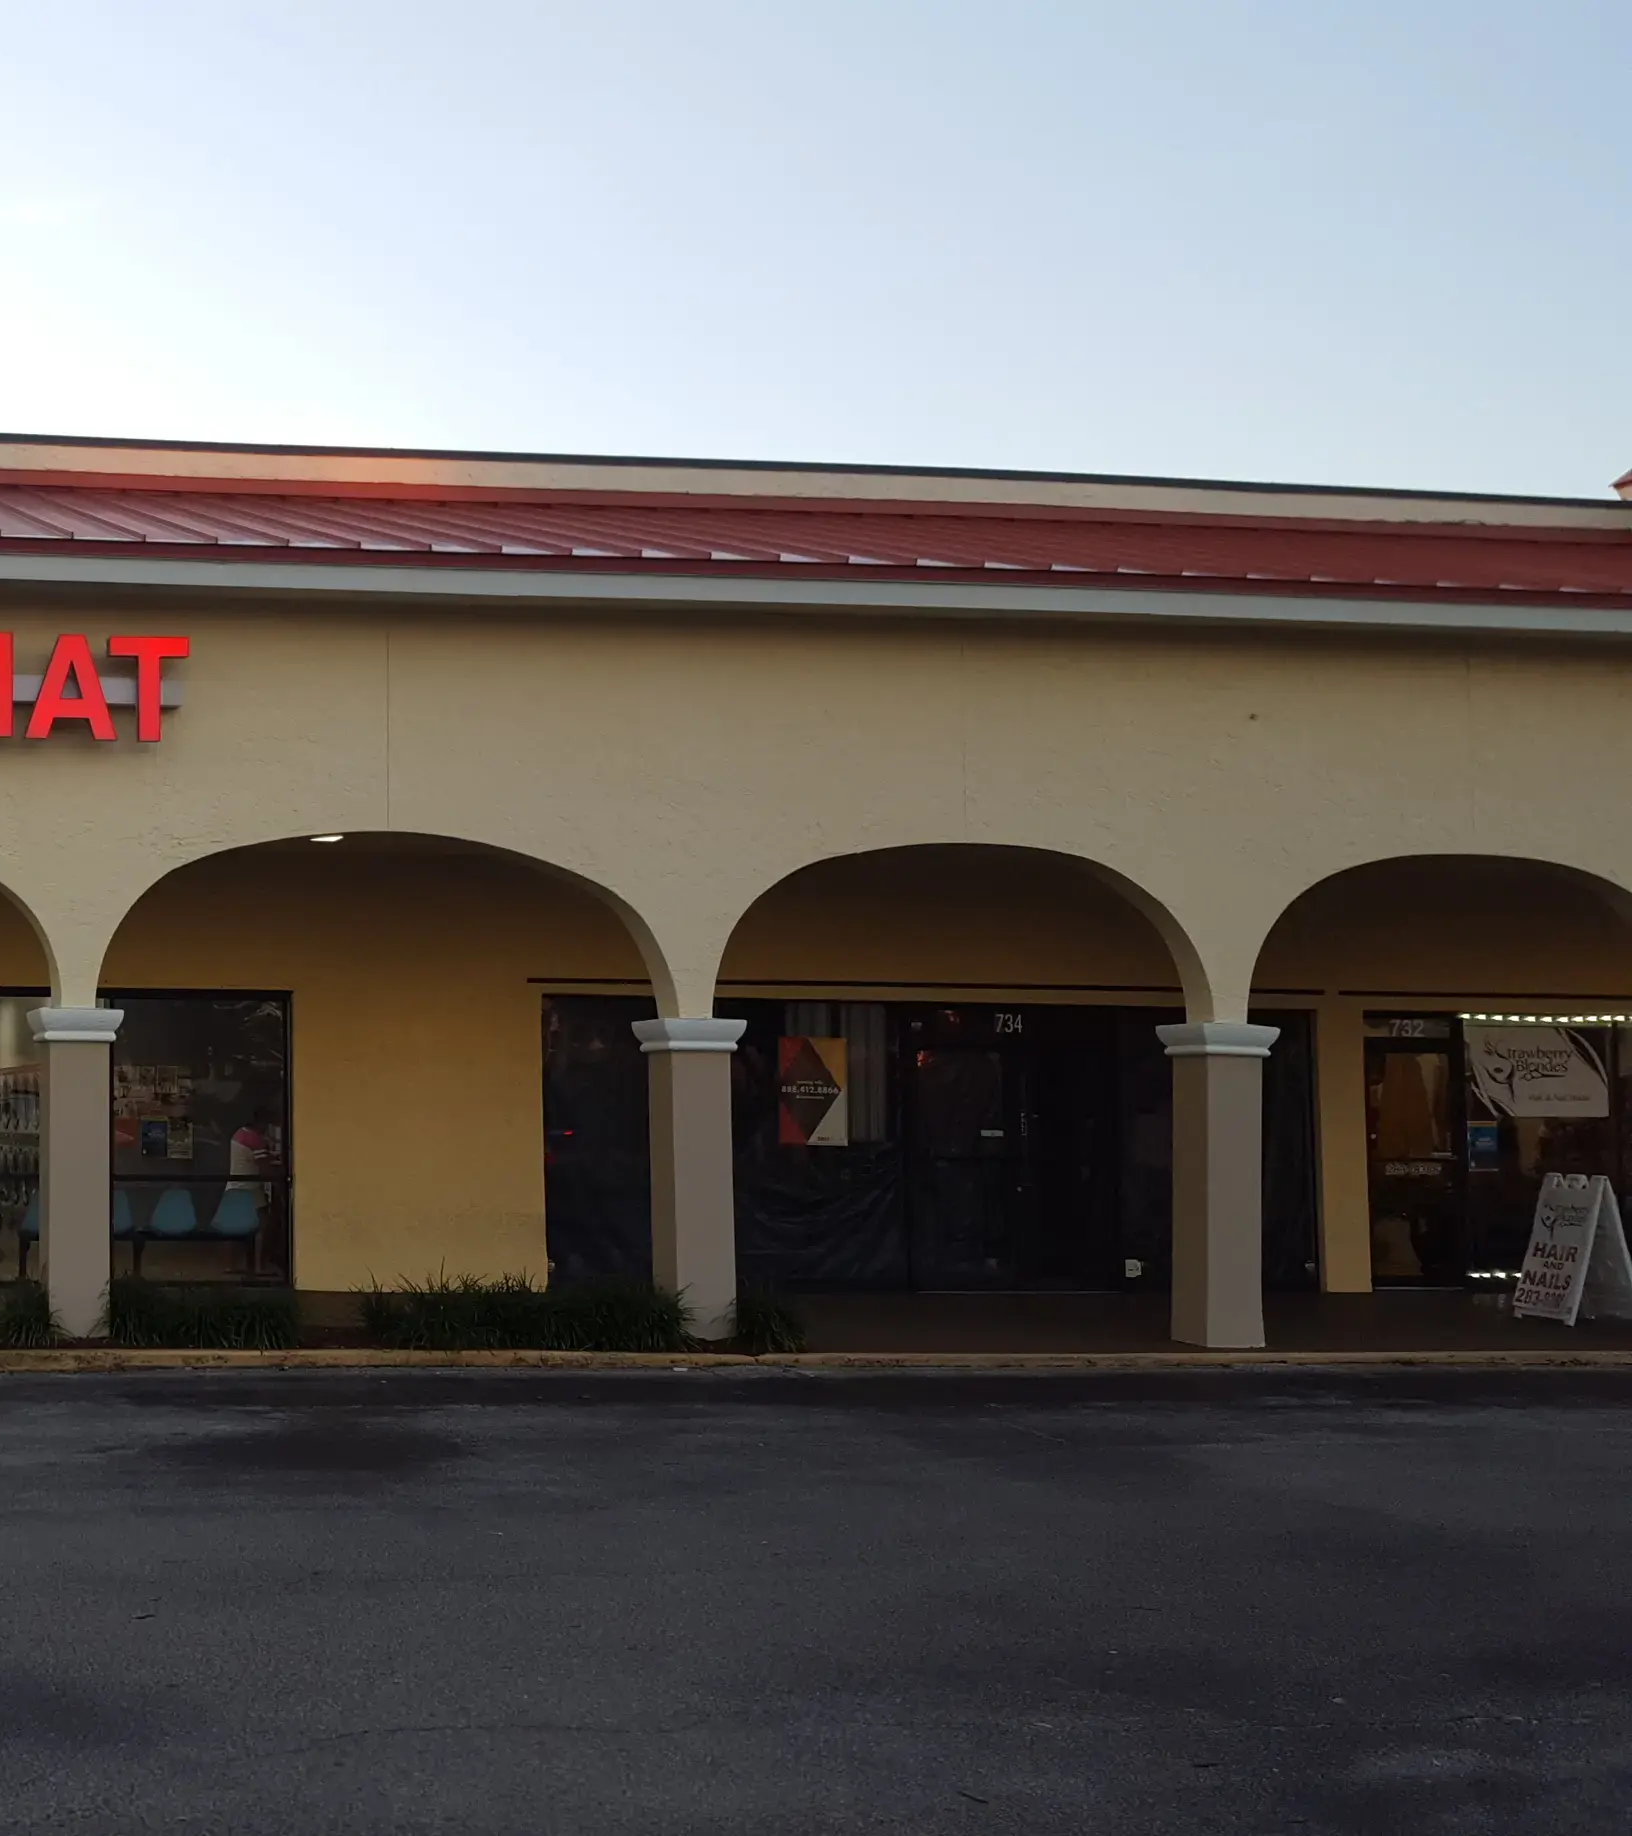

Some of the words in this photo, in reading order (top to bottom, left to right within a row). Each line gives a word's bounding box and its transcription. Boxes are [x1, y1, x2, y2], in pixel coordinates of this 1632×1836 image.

[995, 1013, 1023, 1033] 734
[1388, 1018, 1425, 1038] 732
[1533, 1241, 1579, 1264] HAIR
[1542, 1261, 1565, 1271] AND
[1522, 1269, 1572, 1290] NAILS
